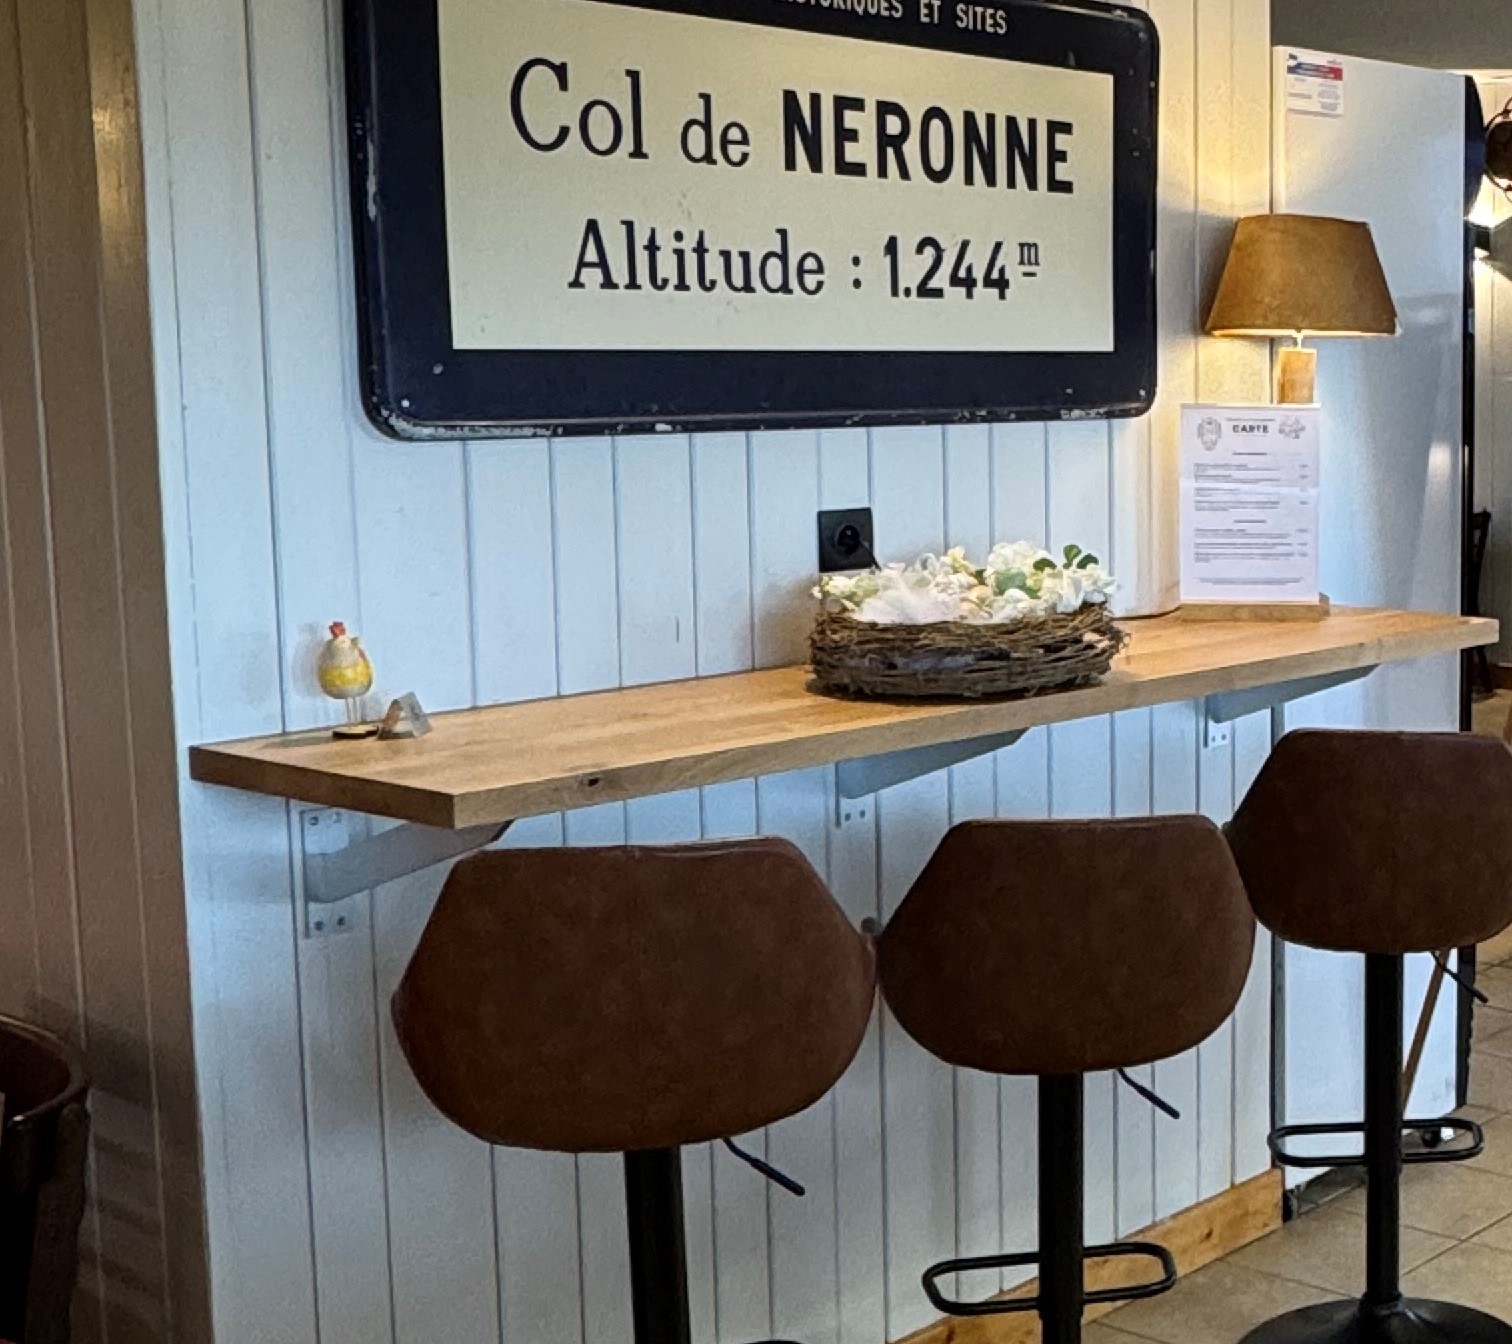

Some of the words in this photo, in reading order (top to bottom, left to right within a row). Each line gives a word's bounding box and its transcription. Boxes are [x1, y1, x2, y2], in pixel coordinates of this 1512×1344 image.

[955, 2, 1008, 35] SITES
[509, 56, 650, 160] Col
[679, 92, 751, 168] de
[782, 88, 1075, 195] NERONNE
[566, 217, 826, 297] Altitude
